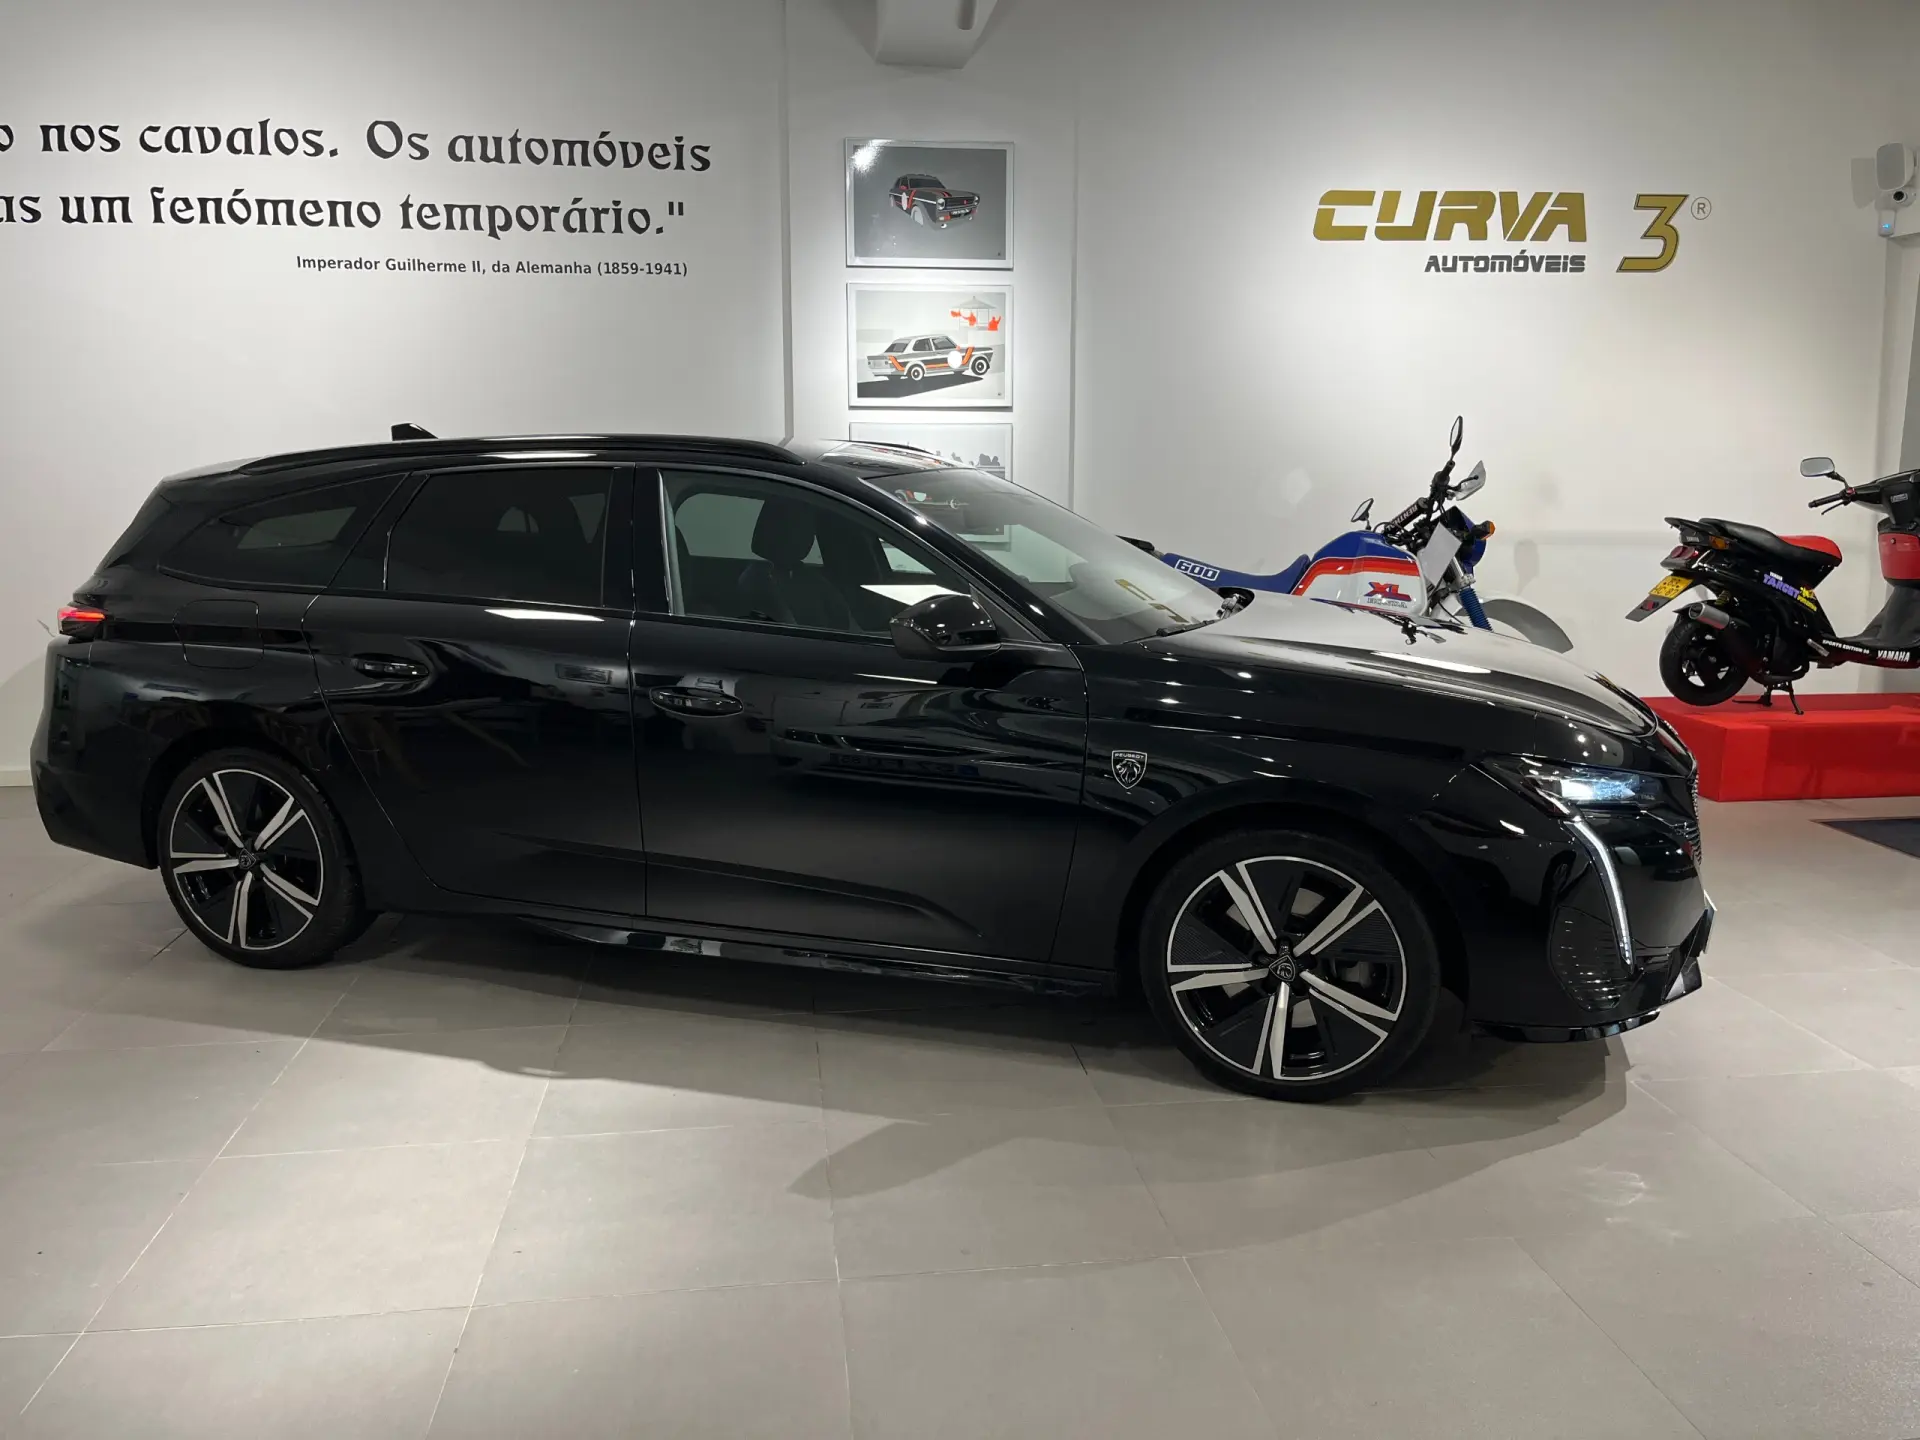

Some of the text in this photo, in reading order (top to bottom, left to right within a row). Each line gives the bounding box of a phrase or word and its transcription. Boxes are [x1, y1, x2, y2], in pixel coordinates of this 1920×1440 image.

[39, 124, 120, 153] nos
[138, 118, 339, 158] cavalos.
[366, 119, 430, 161] Os
[447, 129, 711, 172] automóveis
[59, 196, 134, 224] um
[149, 187, 382, 228] fenómeno
[399, 193, 684, 240] temporário."
[1313, 190, 1587, 242] CURVA
[296, 255, 380, 272] Imperador
[385, 257, 467, 273] Guilherme
[491, 259, 510, 274] da
[515, 261, 592, 275] Alemanha
[597, 261, 688, 277] (1859-1941)
[1424, 249, 1587, 273] AUTOMÓVEIS
[1175, 559, 1220, 582] 600
[1363, 581, 1412, 602] XL
[1876, 649, 1911, 663] YAMAHA
